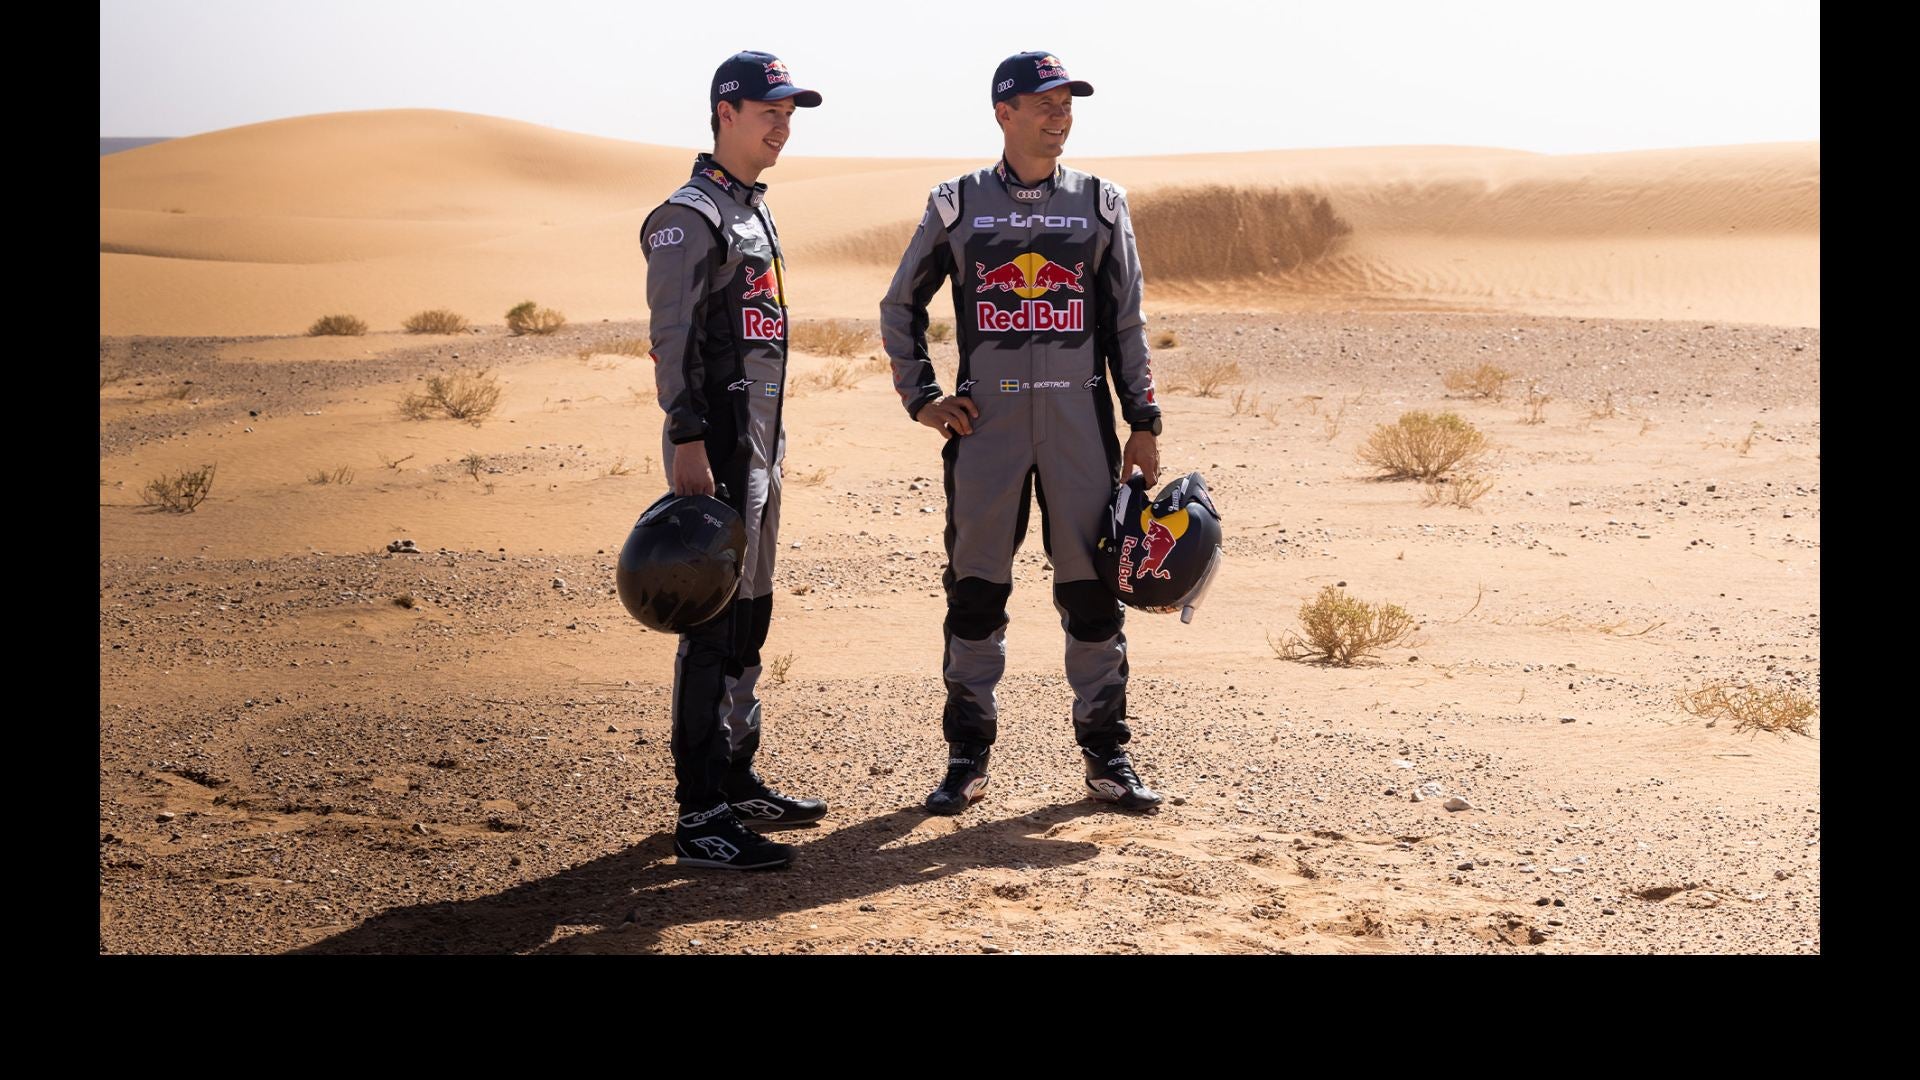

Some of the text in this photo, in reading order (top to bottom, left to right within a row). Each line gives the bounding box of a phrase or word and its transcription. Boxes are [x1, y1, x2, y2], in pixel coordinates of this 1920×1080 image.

[767, 73, 785, 84] Red
[1038, 68, 1058, 79] Red
[973, 211, 1088, 229] e-tron
[742, 305, 784, 340] Red
[977, 299, 1084, 332] Red Bull
[1117, 535, 1138, 593] Red Bull
